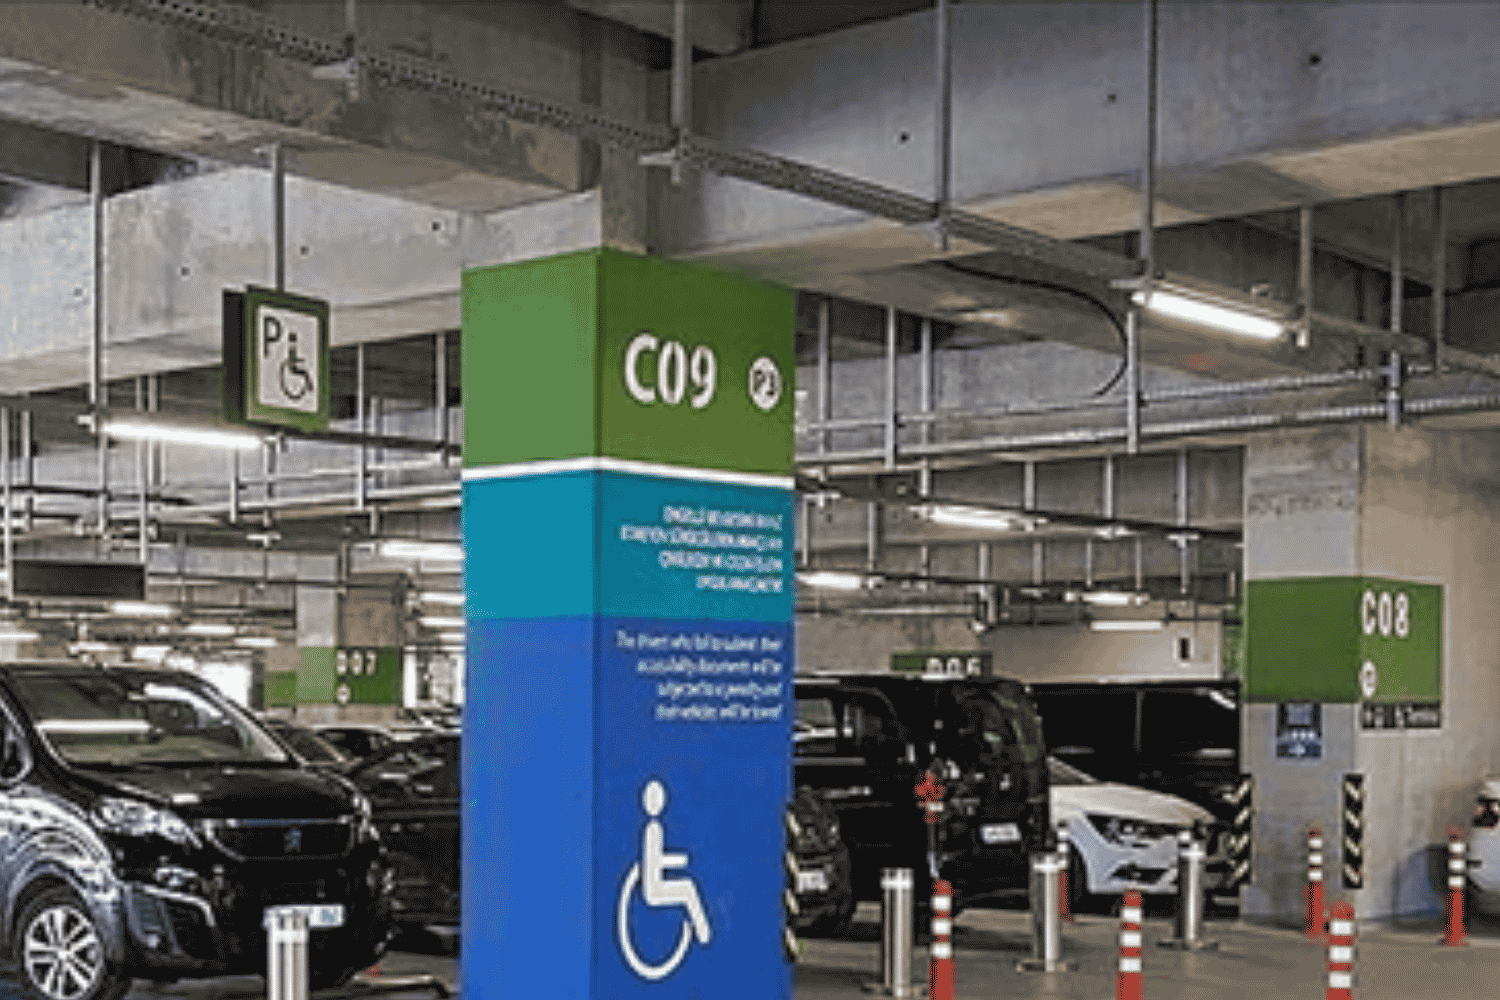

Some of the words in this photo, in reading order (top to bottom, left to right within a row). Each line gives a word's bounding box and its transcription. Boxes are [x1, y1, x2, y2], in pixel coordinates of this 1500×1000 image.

[264, 316, 281, 359] P
[625, 333, 717, 409] C09
[1362, 589, 1408, 638] C08
